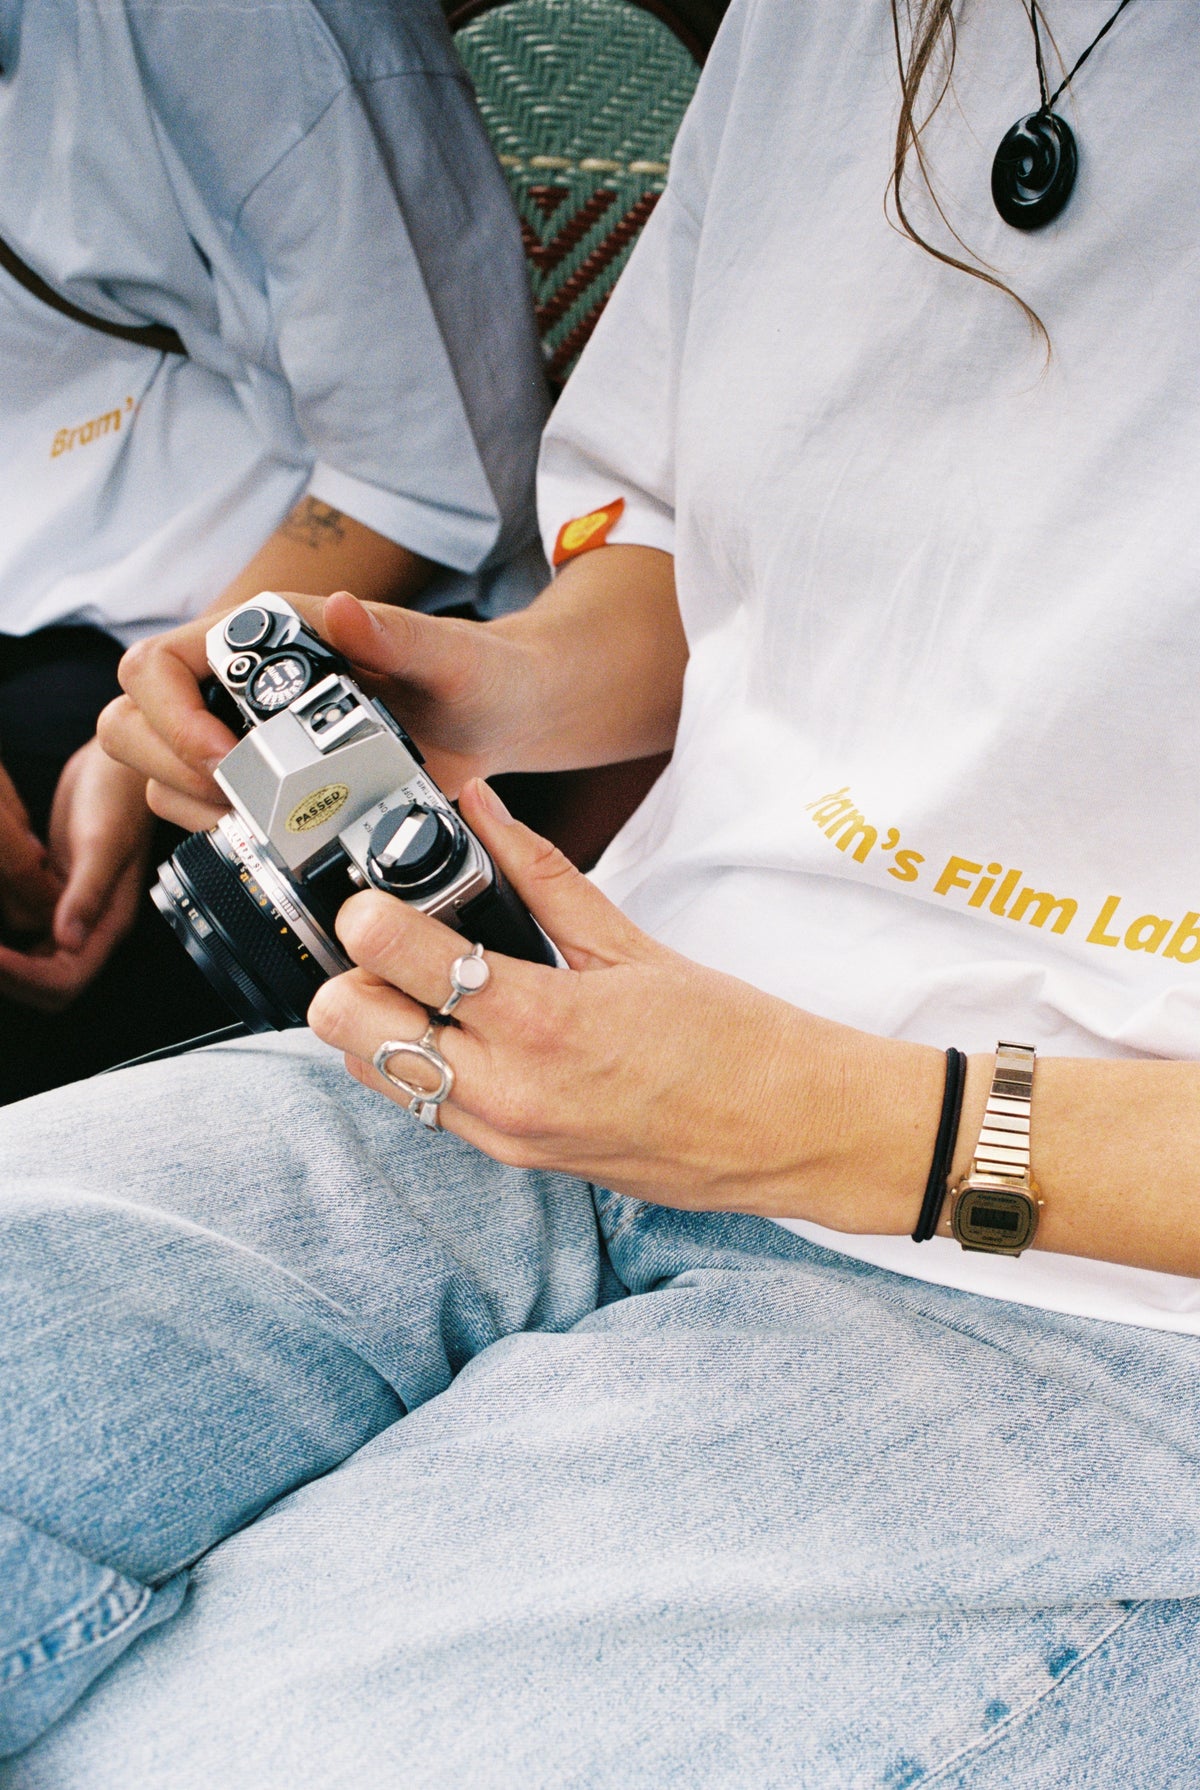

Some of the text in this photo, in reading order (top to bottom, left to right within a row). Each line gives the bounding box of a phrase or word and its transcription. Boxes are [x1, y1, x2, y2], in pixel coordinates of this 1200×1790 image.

[401, 786, 414, 799] OFF
[295, 791, 340, 826] PASSED
[377, 801, 389, 814] ON
[932, 855, 1079, 936] Film
[1085, 894, 1200, 965] Lab
